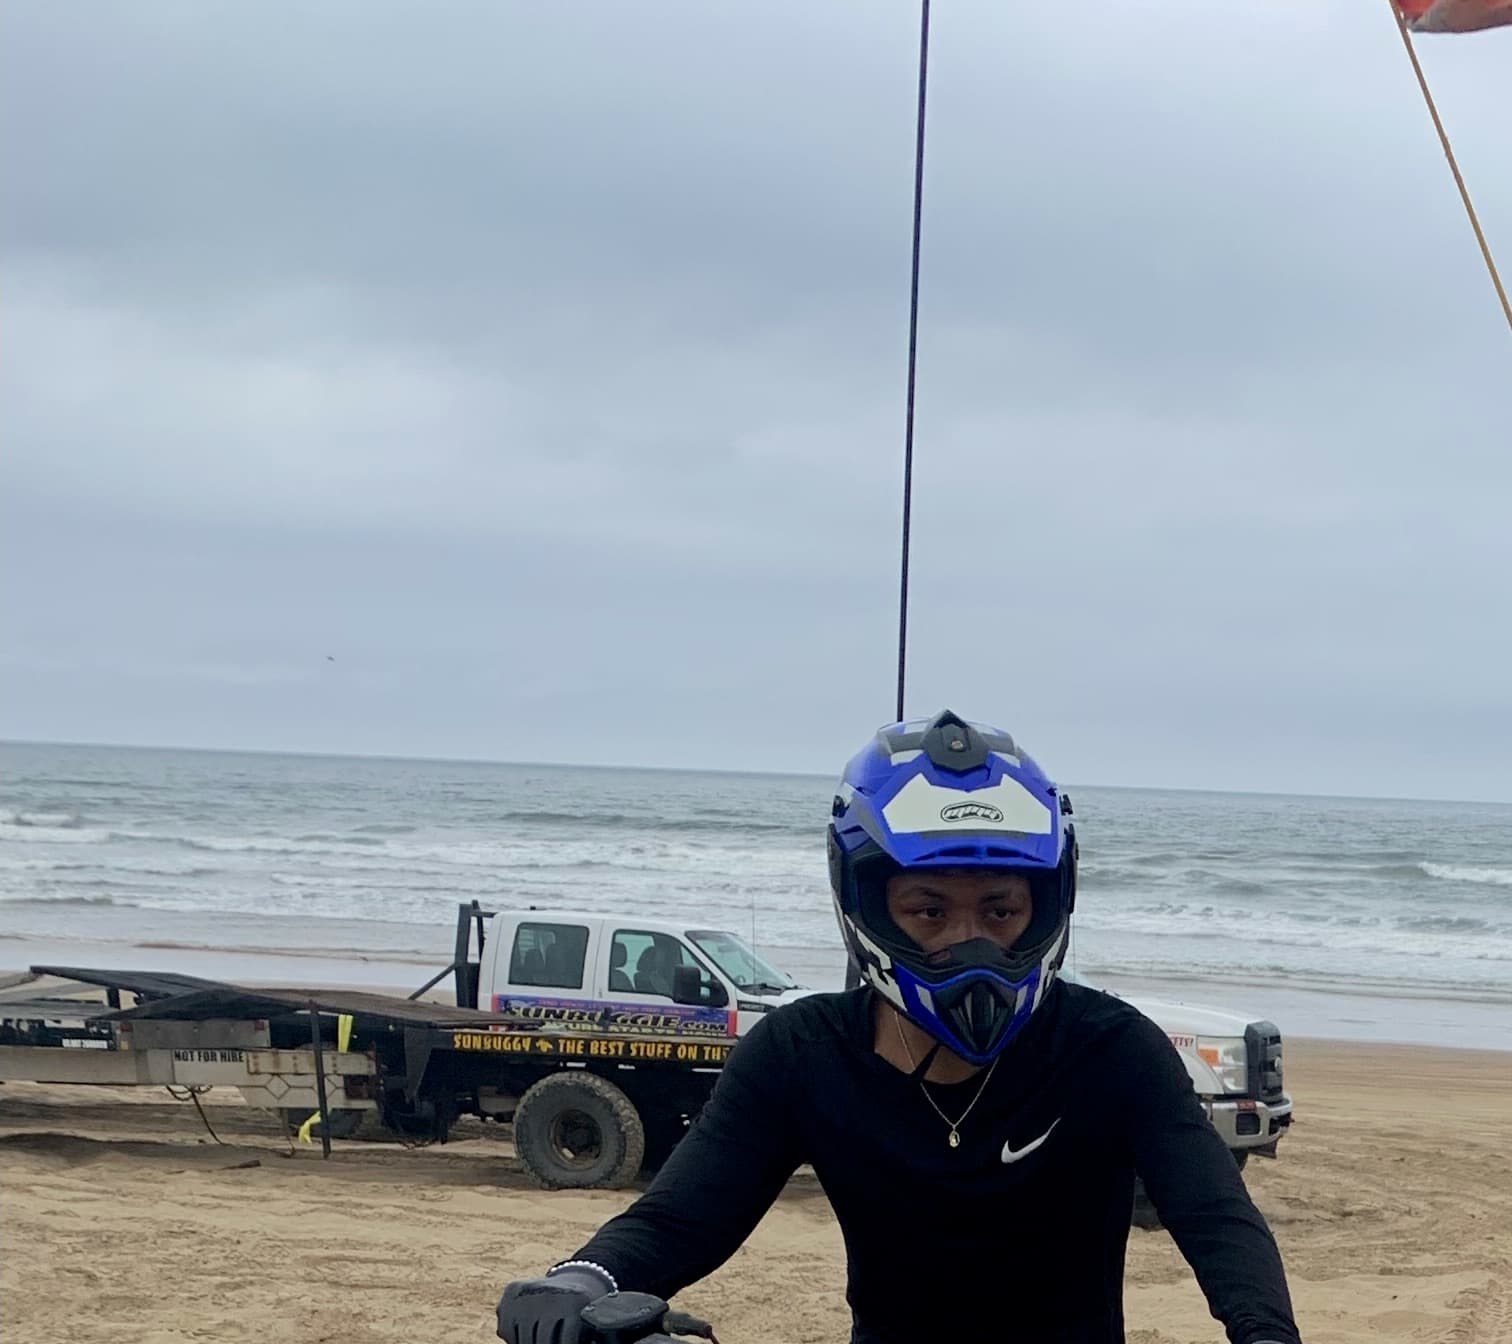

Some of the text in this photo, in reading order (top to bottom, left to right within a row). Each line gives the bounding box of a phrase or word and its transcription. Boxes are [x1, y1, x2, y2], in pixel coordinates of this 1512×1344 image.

[453, 1033, 531, 1052] SUNBUGGY
[558, 1039, 584, 1054] THE
[590, 1040, 624, 1056] BEST
[630, 1042, 672, 1058] STUFF
[677, 1044, 698, 1060] ON
